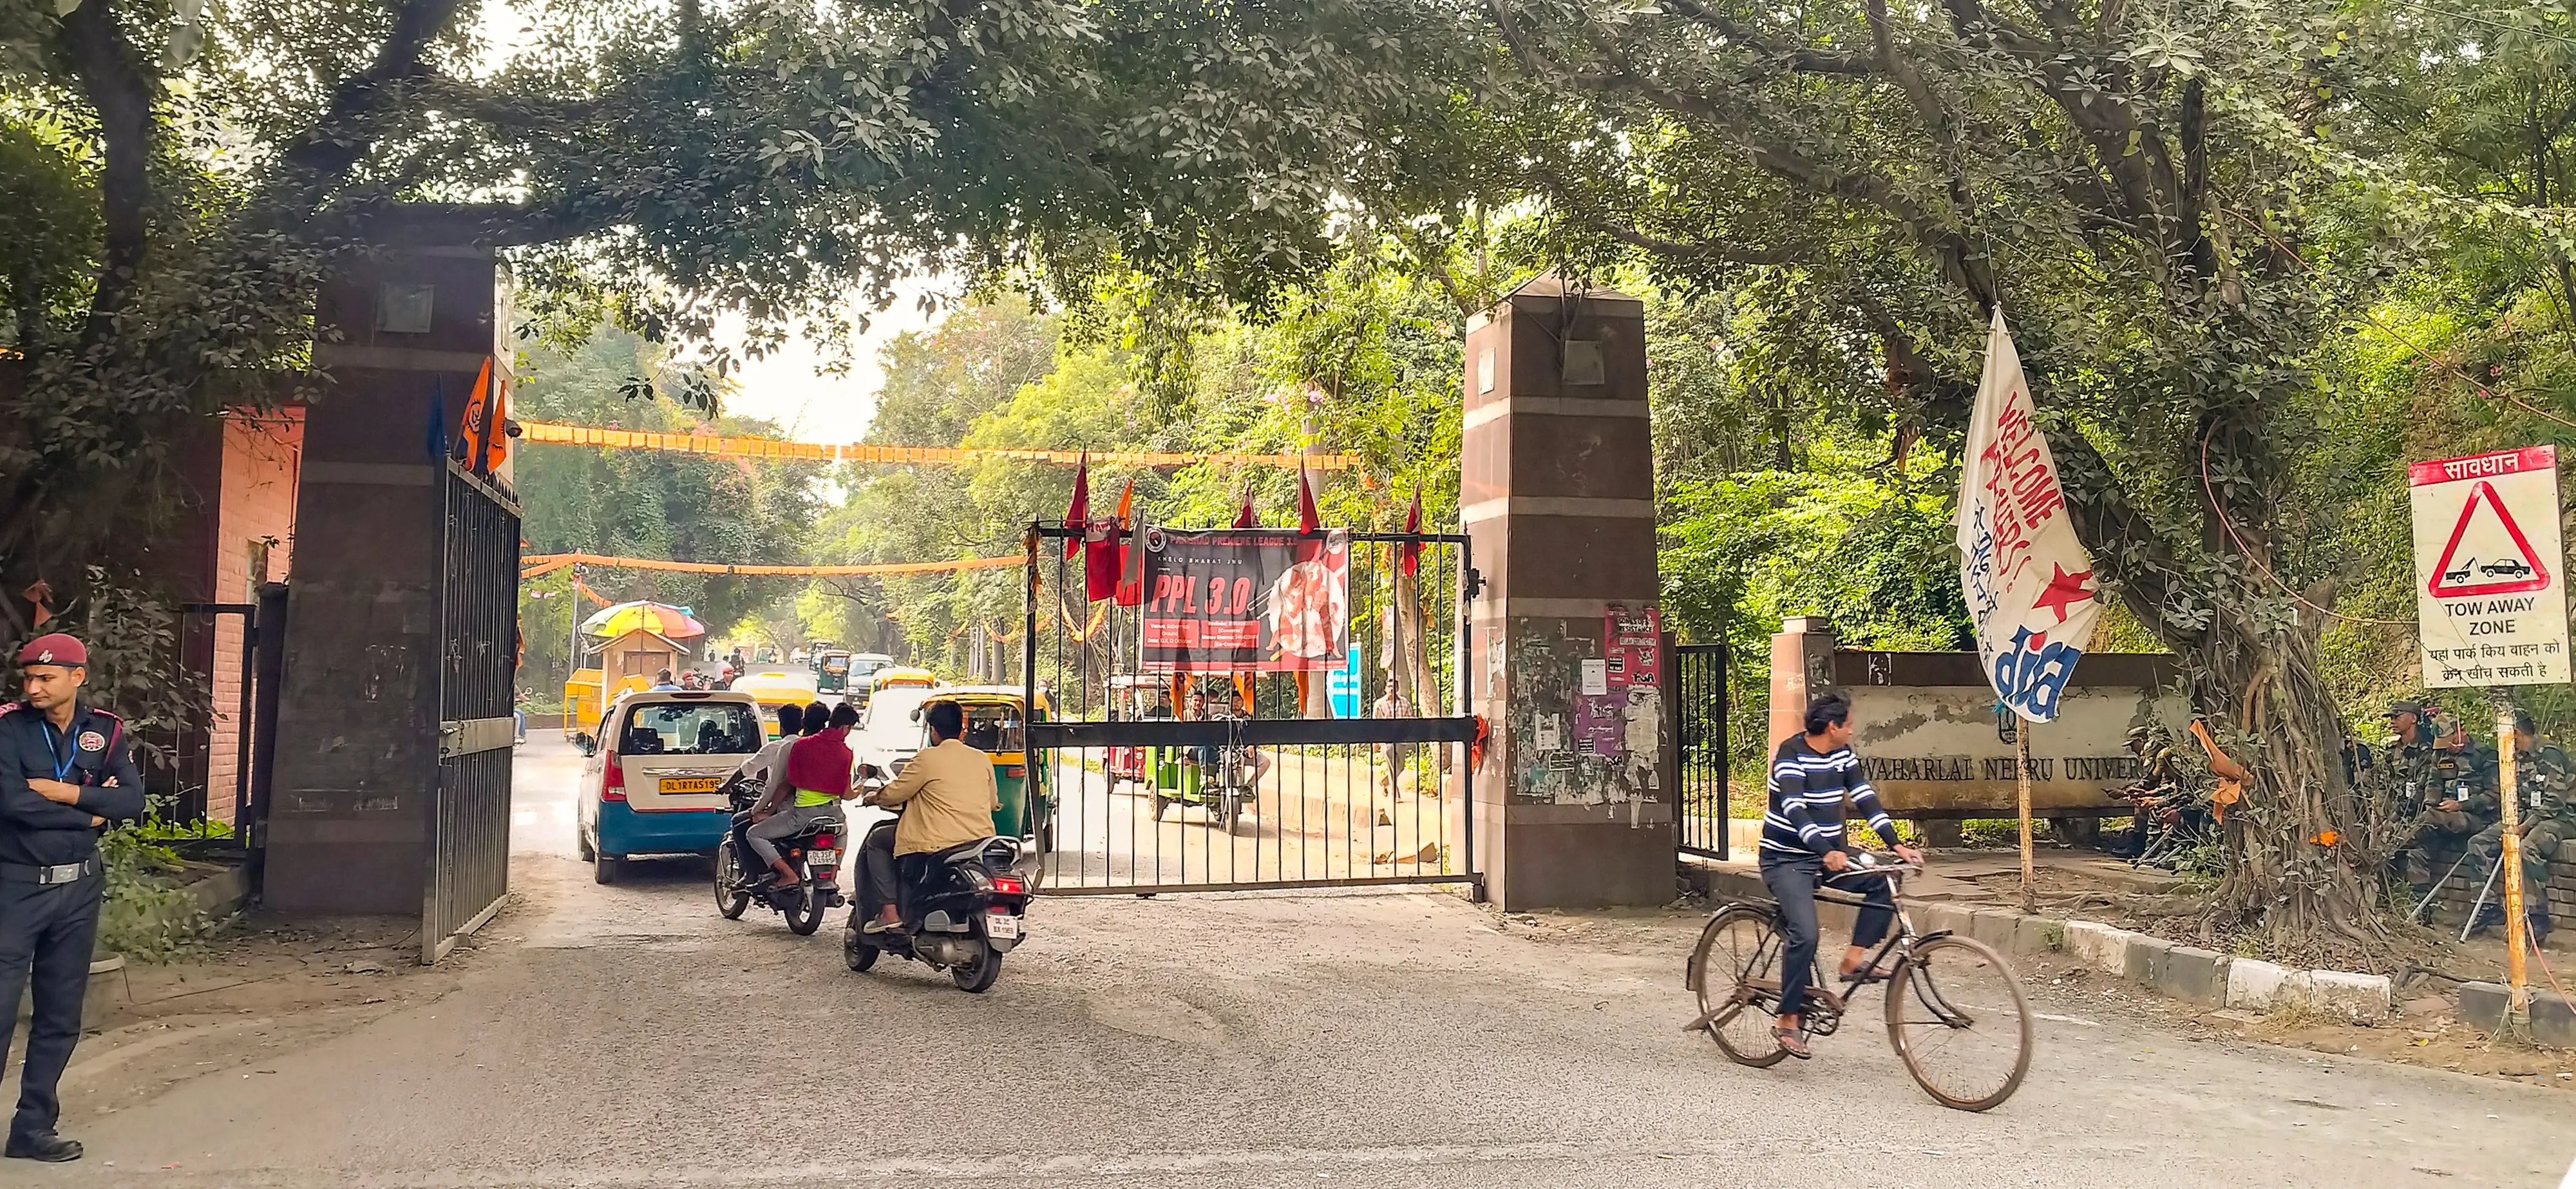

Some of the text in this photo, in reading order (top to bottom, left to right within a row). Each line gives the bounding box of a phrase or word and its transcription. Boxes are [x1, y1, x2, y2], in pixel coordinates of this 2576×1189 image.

[1998, 390, 2065, 531] WELCOME
[2443, 452, 2519, 480] सावधान
[1253, 537, 1284, 546] LEAGUE
[1150, 574, 1251, 615] PPL 3.0
[2445, 596, 2535, 616] TOW AWAY
[2469, 619, 2515, 636] ZONE
[2429, 647, 2448, 661] यहां
[2452, 643, 2476, 660] पार्क
[2510, 644, 2539, 656] वाहन
[2543, 638, 2560, 654] को
[2496, 661, 2533, 677] सकती
[2537, 660, 2547, 677] है
[1857, 756, 2142, 781] WAHARLAL NERU UNIVER
